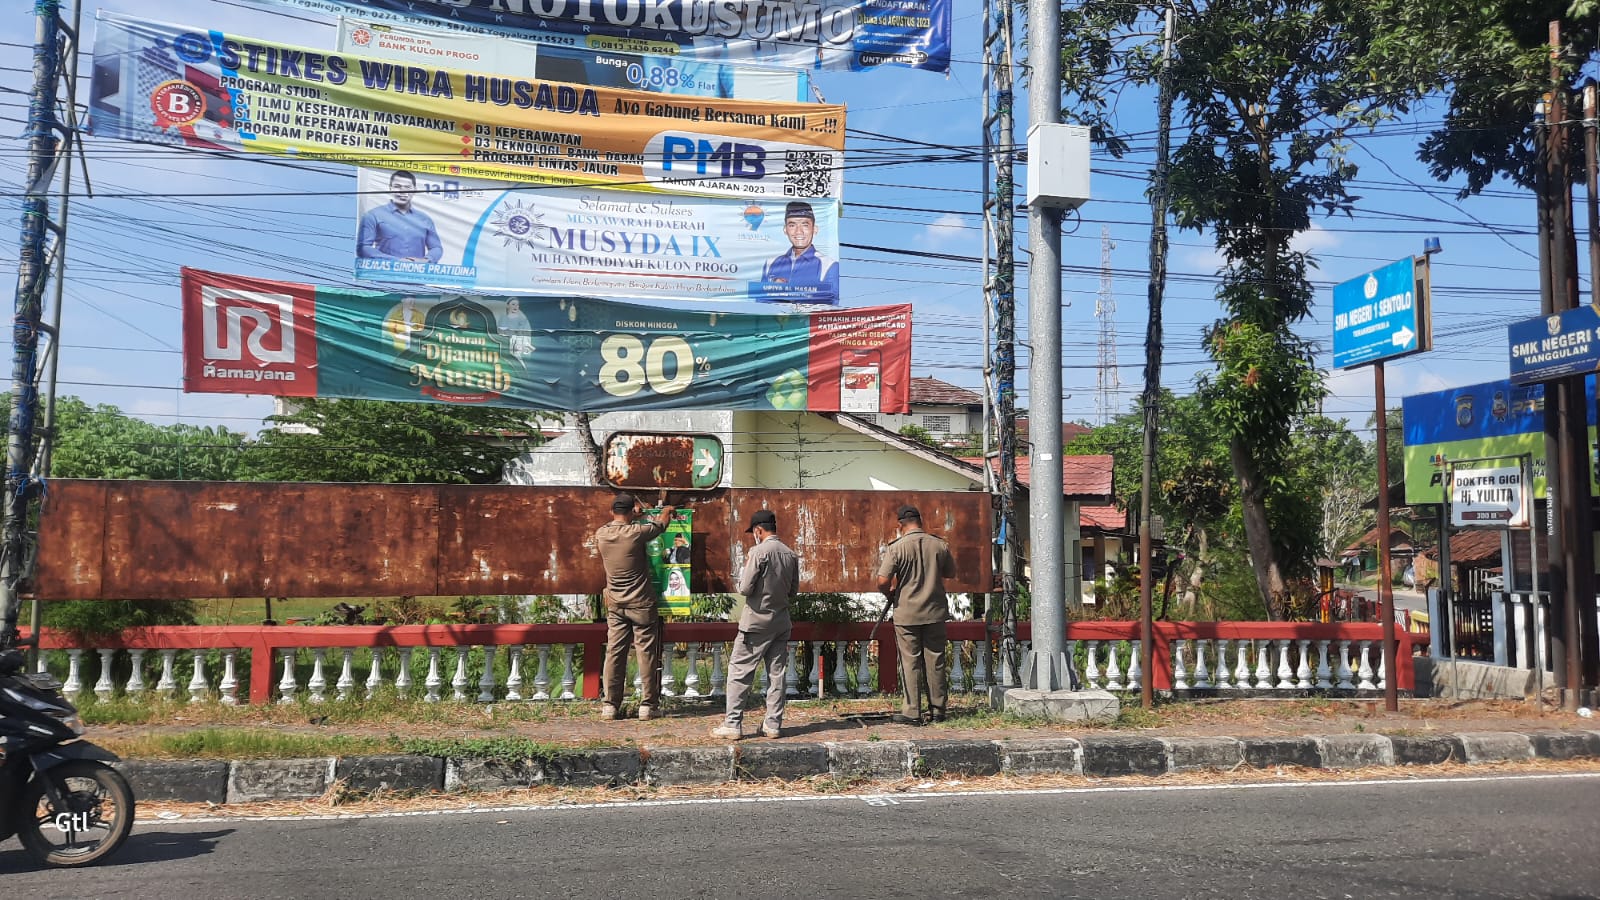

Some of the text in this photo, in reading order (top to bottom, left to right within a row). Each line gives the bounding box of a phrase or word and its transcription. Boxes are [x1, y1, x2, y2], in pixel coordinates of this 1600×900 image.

[888, 15, 914, 28] AGUSTUS
[916, 17, 930, 28] 2023
[379, 33, 415, 44] PERUMDA
[487, 29, 543, 43] Yogyakarta
[544, 35, 575, 46] 55243
[378, 41, 480, 61] BANK KULON PROGO
[595, 55, 628, 67] Bunga
[862, 55, 893, 64] UNTUK
[219, 40, 600, 117] STIKES WIRA HUSADA
[219, 75, 281, 96] PROGRAM
[285, 85, 321, 100] STUDI
[626, 62, 716, 91] 0,88% Flat
[168, 92, 190, 114] B
[236, 92, 455, 132] S1 ILMU KESEHATAN MASYARAKAT
[614, 98, 640, 115] Ayo
[645, 101, 700, 121] Gabung
[704, 107, 766, 126] Bersama
[770, 113, 806, 130] Kami
[235, 106, 389, 138] S1 ILMU KEPERAWATAN
[234, 120, 398, 151] PROGRAM PROFESI NERS
[474, 124, 582, 146] D3 KEPERAWATAN
[474, 136, 645, 166] D3 TEKNOLOGI BANK DARAH
[662, 135, 767, 180] PMB
[474, 150, 618, 176] PROGRAM LINTAS JALUR
[424, 183, 441, 196] 12
[662, 176, 765, 194] TAHUN AJARAN 2023
[578, 195, 693, 217] Selamat & Sukses
[566, 213, 705, 231] MUSYAWARAH DAERAH
[549, 226, 722, 258] MUSYDA IX
[427, 264, 475, 277] PRATIDINA
[531, 252, 738, 275] MUHAMMADIYAH KULON PROGO
[1335, 291, 1411, 331] SMA NEGERI 1 SENTOLO
[615, 320, 678, 329] DISKON HINGGA
[435, 332, 486, 346] Lebaran
[840, 339, 867, 347] HINGGA
[1512, 341, 1538, 357] SMK
[1541, 329, 1591, 351] NEGERI
[421, 343, 499, 365] Dijamin
[1524, 344, 1588, 365] NANGGULAN
[203, 365, 296, 381] Ramayana
[409, 361, 511, 392] Murah
[1456, 475, 1495, 487] DOKTER
[1499, 474, 1520, 485] GIGI
[1461, 488, 1513, 506] Hj. YULITA
